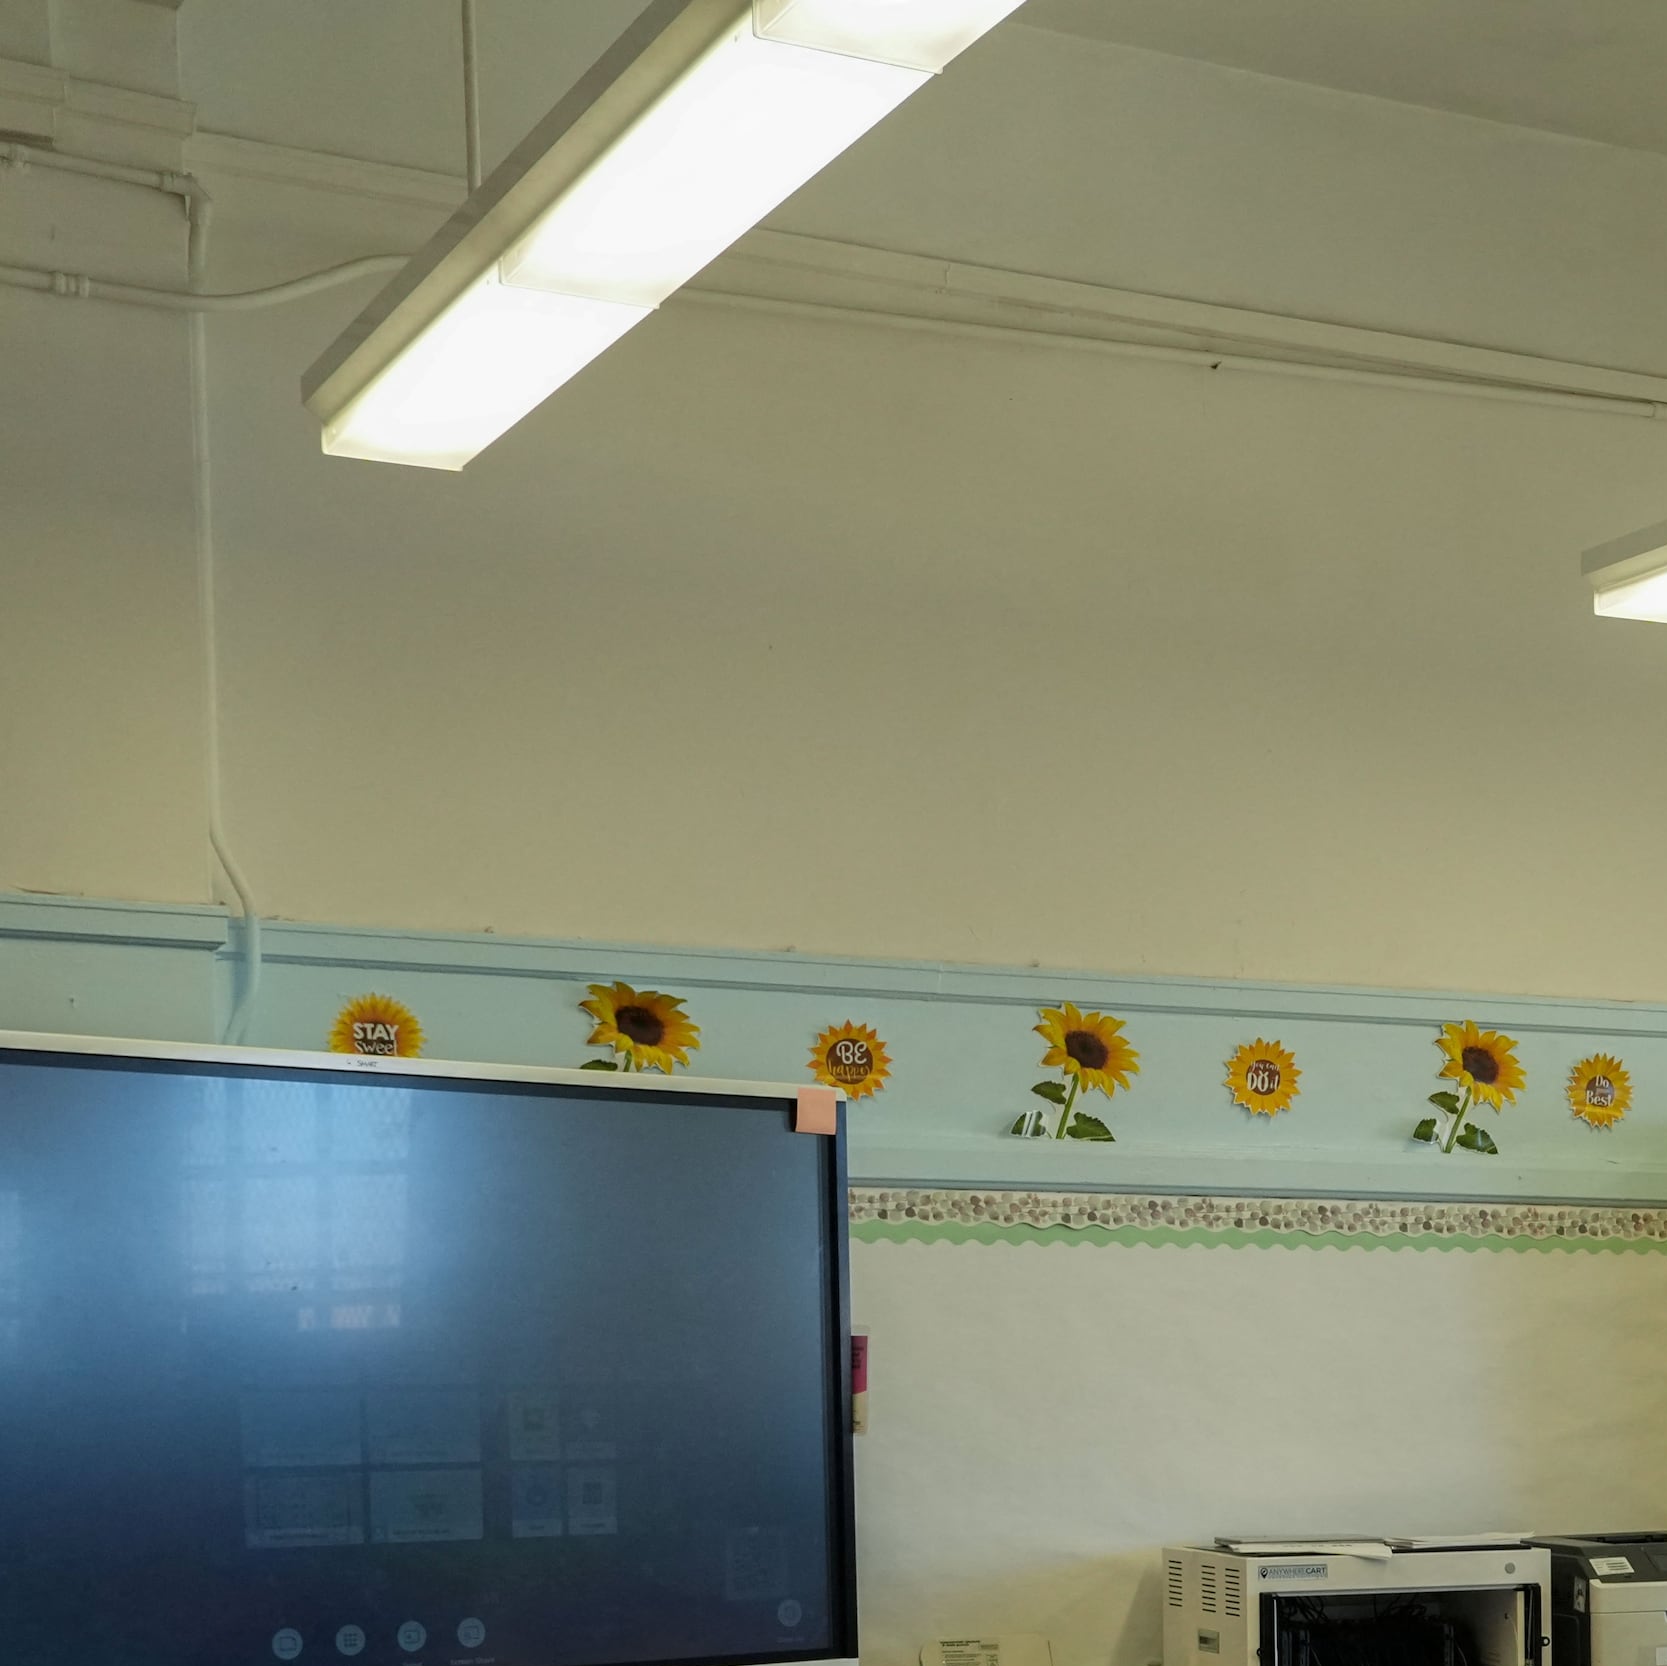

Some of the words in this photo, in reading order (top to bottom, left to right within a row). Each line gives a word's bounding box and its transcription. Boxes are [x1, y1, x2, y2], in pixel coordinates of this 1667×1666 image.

[353, 1022, 399, 1040] STAY
[836, 1041, 865, 1065] BE
[356, 1060, 378, 1068] SMART
[1247, 1070, 1270, 1092] DO
[1595, 1075, 1609, 1089] Do
[1585, 1090, 1613, 1107] Best
[1306, 1567, 1325, 1575] CART
